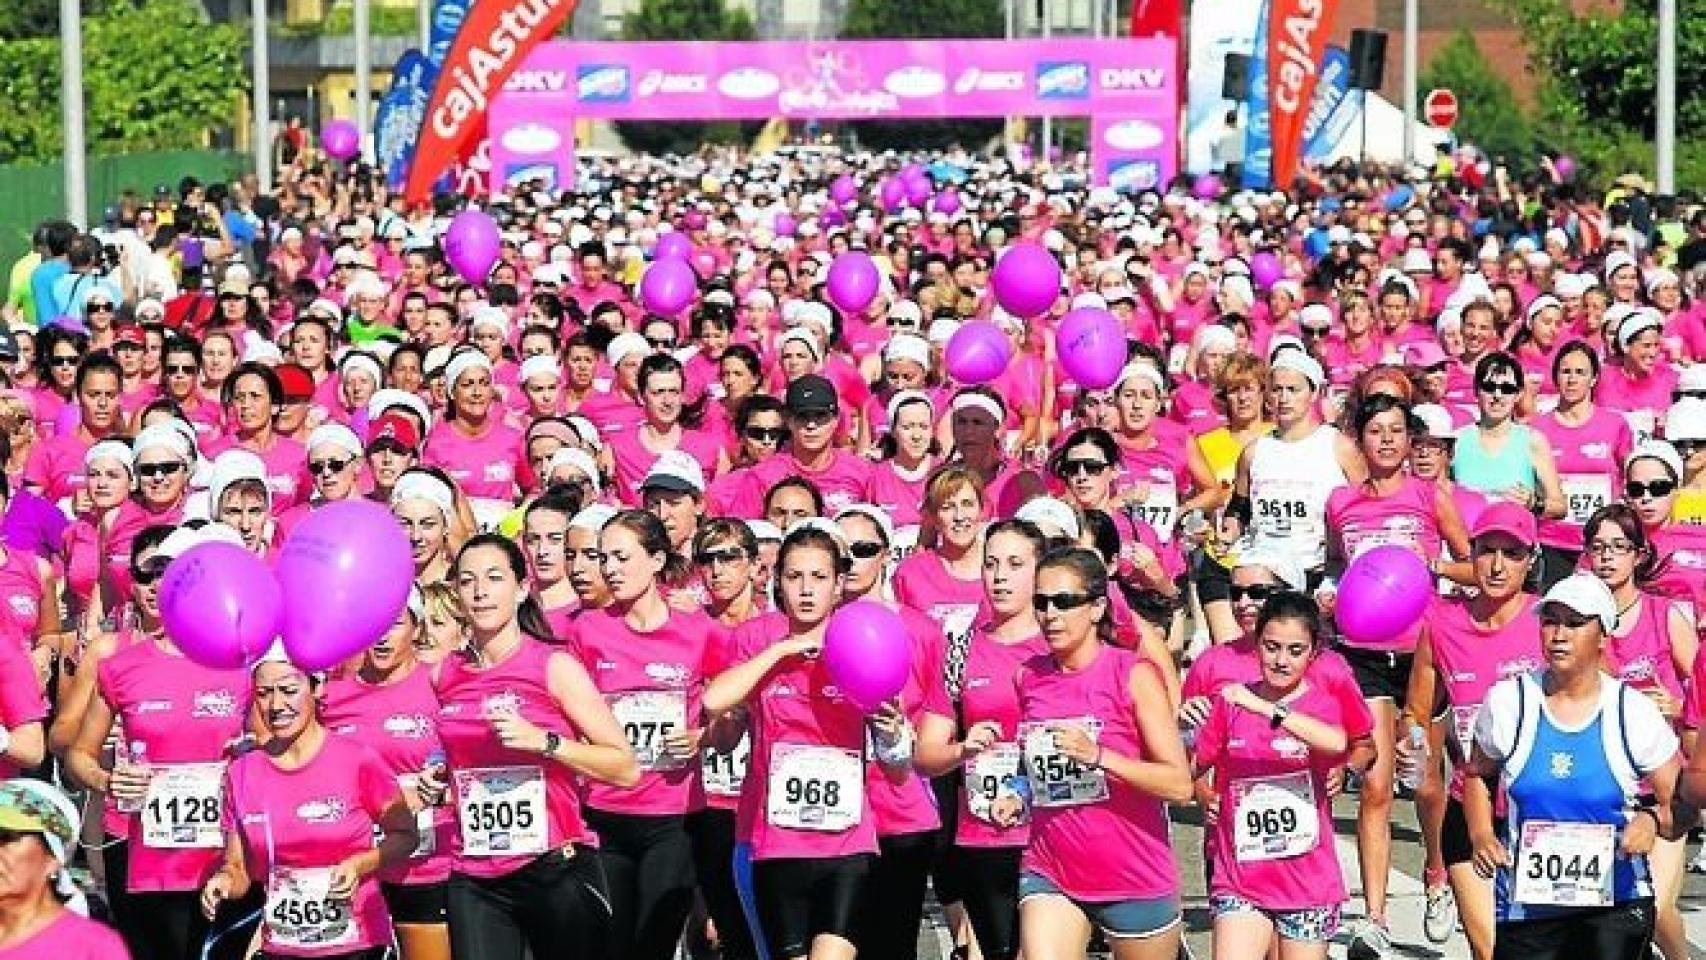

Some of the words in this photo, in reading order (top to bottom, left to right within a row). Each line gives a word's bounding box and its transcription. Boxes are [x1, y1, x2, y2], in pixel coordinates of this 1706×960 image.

[1100, 68, 1166, 90] DKV
[785, 776, 841, 808] 968
[147, 797, 220, 826] 1128
[467, 799, 534, 833] 3505
[1246, 806, 1297, 838] 969
[1526, 852, 1602, 883] 3044
